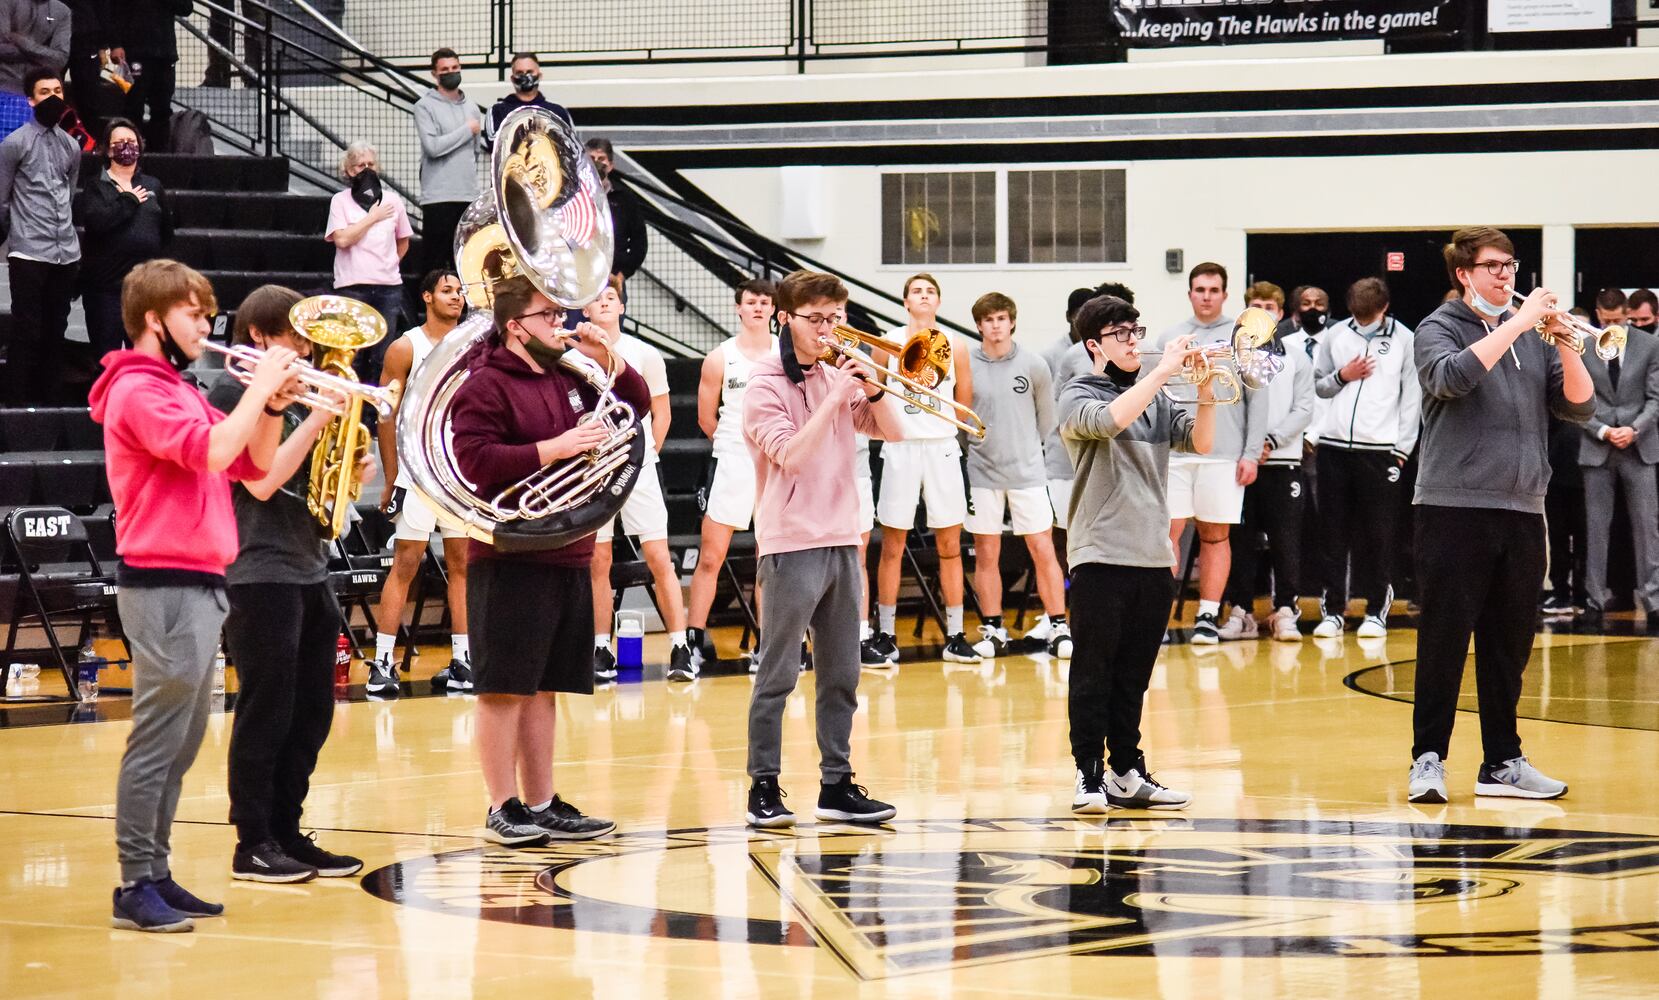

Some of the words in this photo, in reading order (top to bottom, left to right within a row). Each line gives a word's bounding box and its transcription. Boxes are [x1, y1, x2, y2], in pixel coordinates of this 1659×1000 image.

[1120, 18, 1213, 42] ...keeping
[1218, 16, 1252, 35] The
[1255, 12, 1318, 35] Hawks
[1321, 12, 1341, 32] in
[1344, 10, 1377, 31] the
[1379, 6, 1440, 34] game!
[615, 463, 637, 487] YAMAH
[24, 515, 71, 537] EAST
[380, 557, 394, 567] HAW
[352, 574, 377, 584] HAWKS
